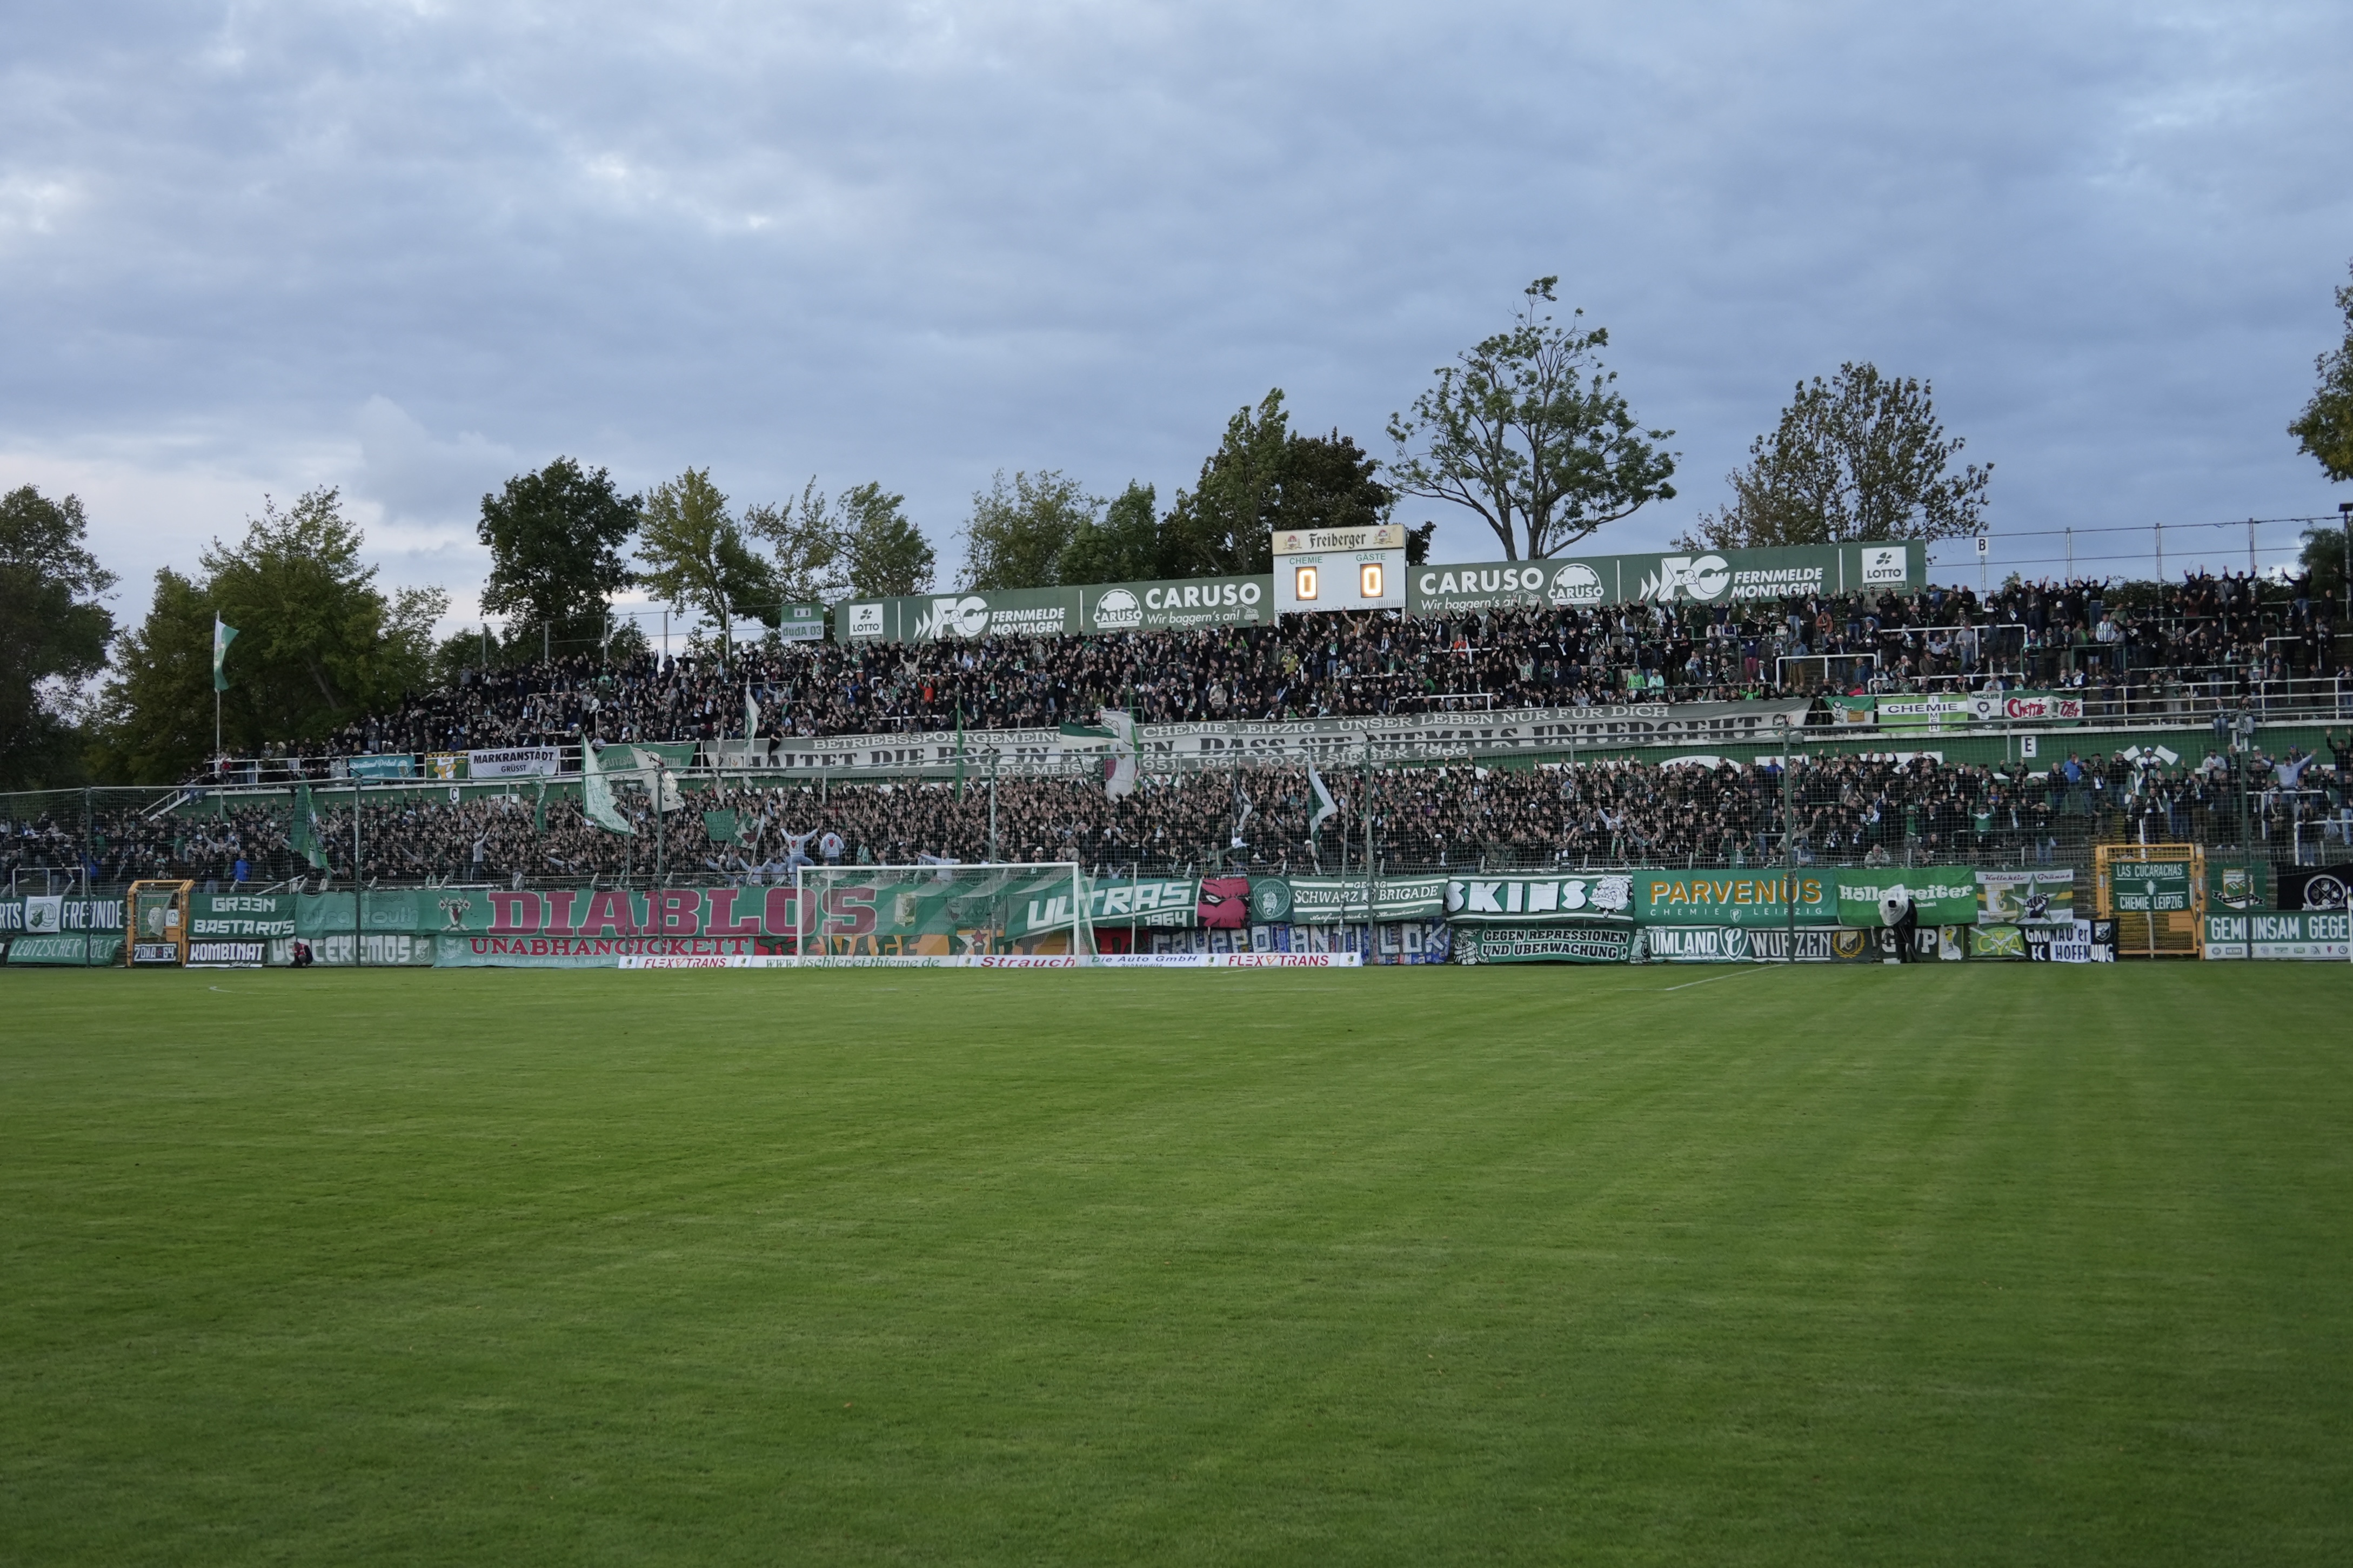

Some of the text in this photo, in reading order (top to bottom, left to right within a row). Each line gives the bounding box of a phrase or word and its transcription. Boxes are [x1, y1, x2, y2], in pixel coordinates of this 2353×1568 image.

[1308, 532, 1366, 549] Freiberger
[1978, 539, 1986, 551] B
[1289, 552, 1386, 565] CHEMIE GÄSTE
[1420, 567, 1543, 595] CARUSO
[1734, 567, 1823, 584] FERNMELDE
[1867, 568, 1901, 579] LOTTO
[1298, 566, 1381, 598] 0 0
[1732, 582, 1822, 598] MONTAGEN
[1145, 582, 1261, 609] CARUSO
[1548, 586, 1604, 599] CARUSO
[1421, 598, 1442, 611] Wir
[991, 607, 1065, 623] FERNMELDE
[1093, 610, 1143, 623] CARUSO
[1147, 608, 1240, 626] Wir baggern's an!
[853, 623, 879, 632] LOTTO
[990, 621, 1064, 636] MONTAGEN
[1888, 703, 1957, 713] CHEMIE
[2008, 698, 2047, 718] Chemie
[1142, 722, 1228, 738] CHEMIE
[1234, 722, 1316, 734] LEIPZIG
[1338, 718, 1414, 731] UNSER
[1420, 714, 1494, 726] LEBEN
[1502, 710, 1550, 723] NUR
[1611, 706, 1669, 718] DICH
[2026, 738, 2032, 752] E
[870, 748, 925, 767] DIE
[1255, 749, 1409, 767] POKALSIEGER
[501, 764, 526, 773] GRÜSST
[452, 789, 457, 801] C
[2116, 864, 2182, 877] LAS CUCARACHAS
[1294, 889, 1358, 904] SCHWARZ
[1379, 886, 1439, 901] BRIGADE
[1446, 880, 1588, 913] SKINS
[2120, 896, 2183, 910] CHEMIE LEIPZIG
[487, 887, 877, 938] DIABLOS
[1027, 880, 1193, 930] ULTRAS
[1650, 907, 1823, 916] CHEMIE LEIPZIG
[63, 900, 124, 929] FREUNDE
[1145, 911, 1187, 926] 1964
[194, 920, 295, 936] BASTARDS
[1483, 929, 1629, 943] GEGEN REPRESSIONEN
[1379, 923, 1446, 954] LOK
[1650, 931, 1718, 954] UMLAND
[10, 938, 82, 957] LEUTZSCHER
[135, 947, 175, 959] ZONA 64
[190, 943, 265, 961] KOMBINAT
[1482, 943, 1510, 956] UND
[1513, 942, 1617, 960] ÜBERWACHUNG
[2031, 944, 2114, 962] FC HOFFNUNG
[683, 957, 727, 968] TRANS
[980, 956, 1075, 967] Strauch
[1279, 955, 1329, 966] TRANS
